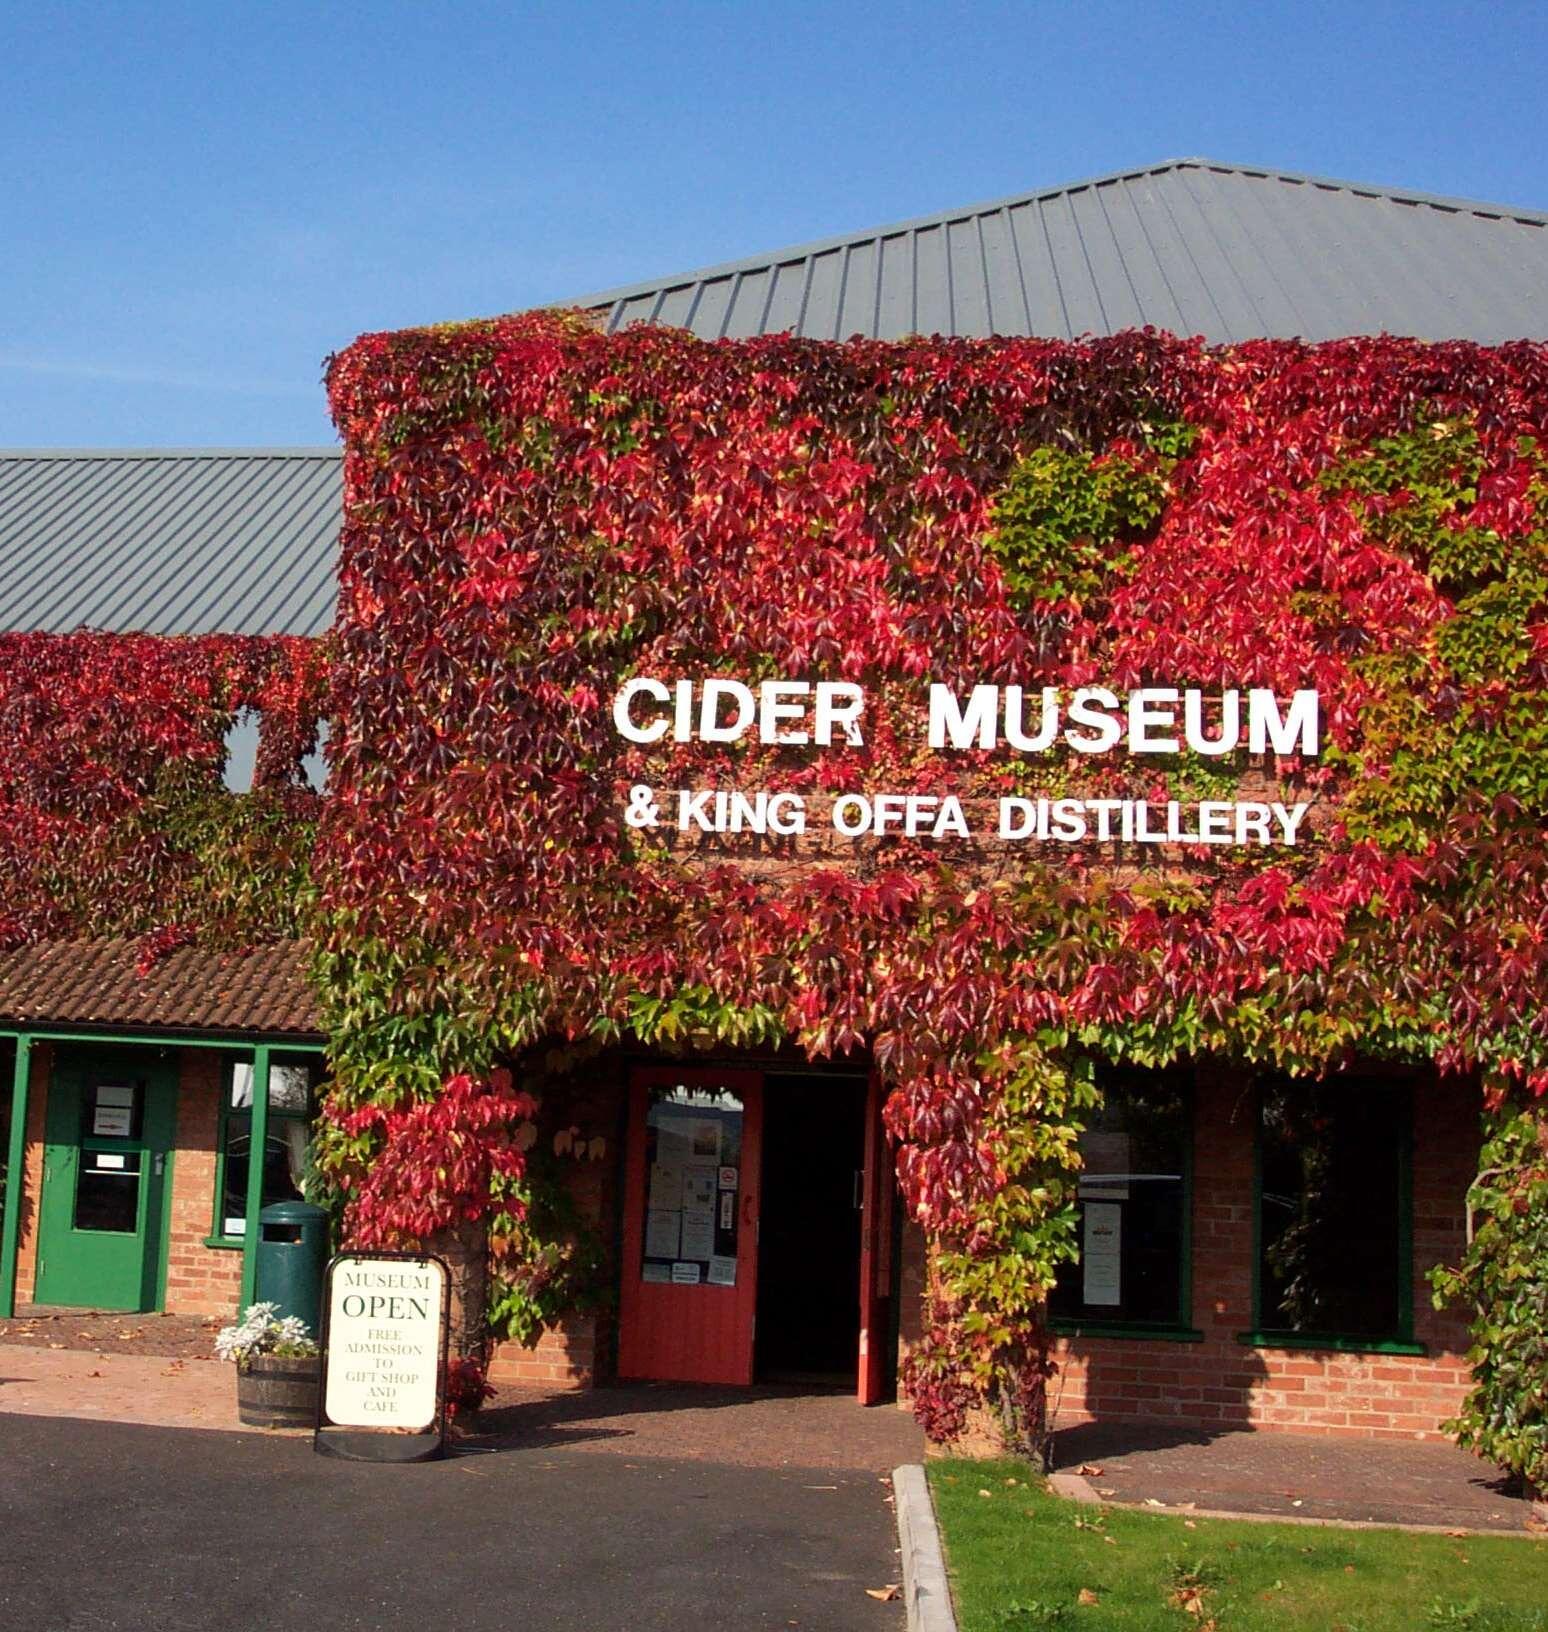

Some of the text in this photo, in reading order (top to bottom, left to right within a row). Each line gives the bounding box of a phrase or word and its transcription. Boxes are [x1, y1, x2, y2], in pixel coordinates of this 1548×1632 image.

[614, 677, 1319, 756] CIDER MUSEUM
[624, 784, 1309, 846] & KING OFFA DISTILLERY
[344, 1272, 430, 1290] MUSEUM
[342, 1294, 430, 1320] OPEN
[368, 1328, 402, 1341] FREE
[345, 1343, 423, 1355] ADMISSION
[374, 1358, 394, 1369] TO
[345, 1371, 420, 1384] GIFT SHOP
[367, 1386, 397, 1398] AND
[362, 1401, 399, 1412] CAFE
